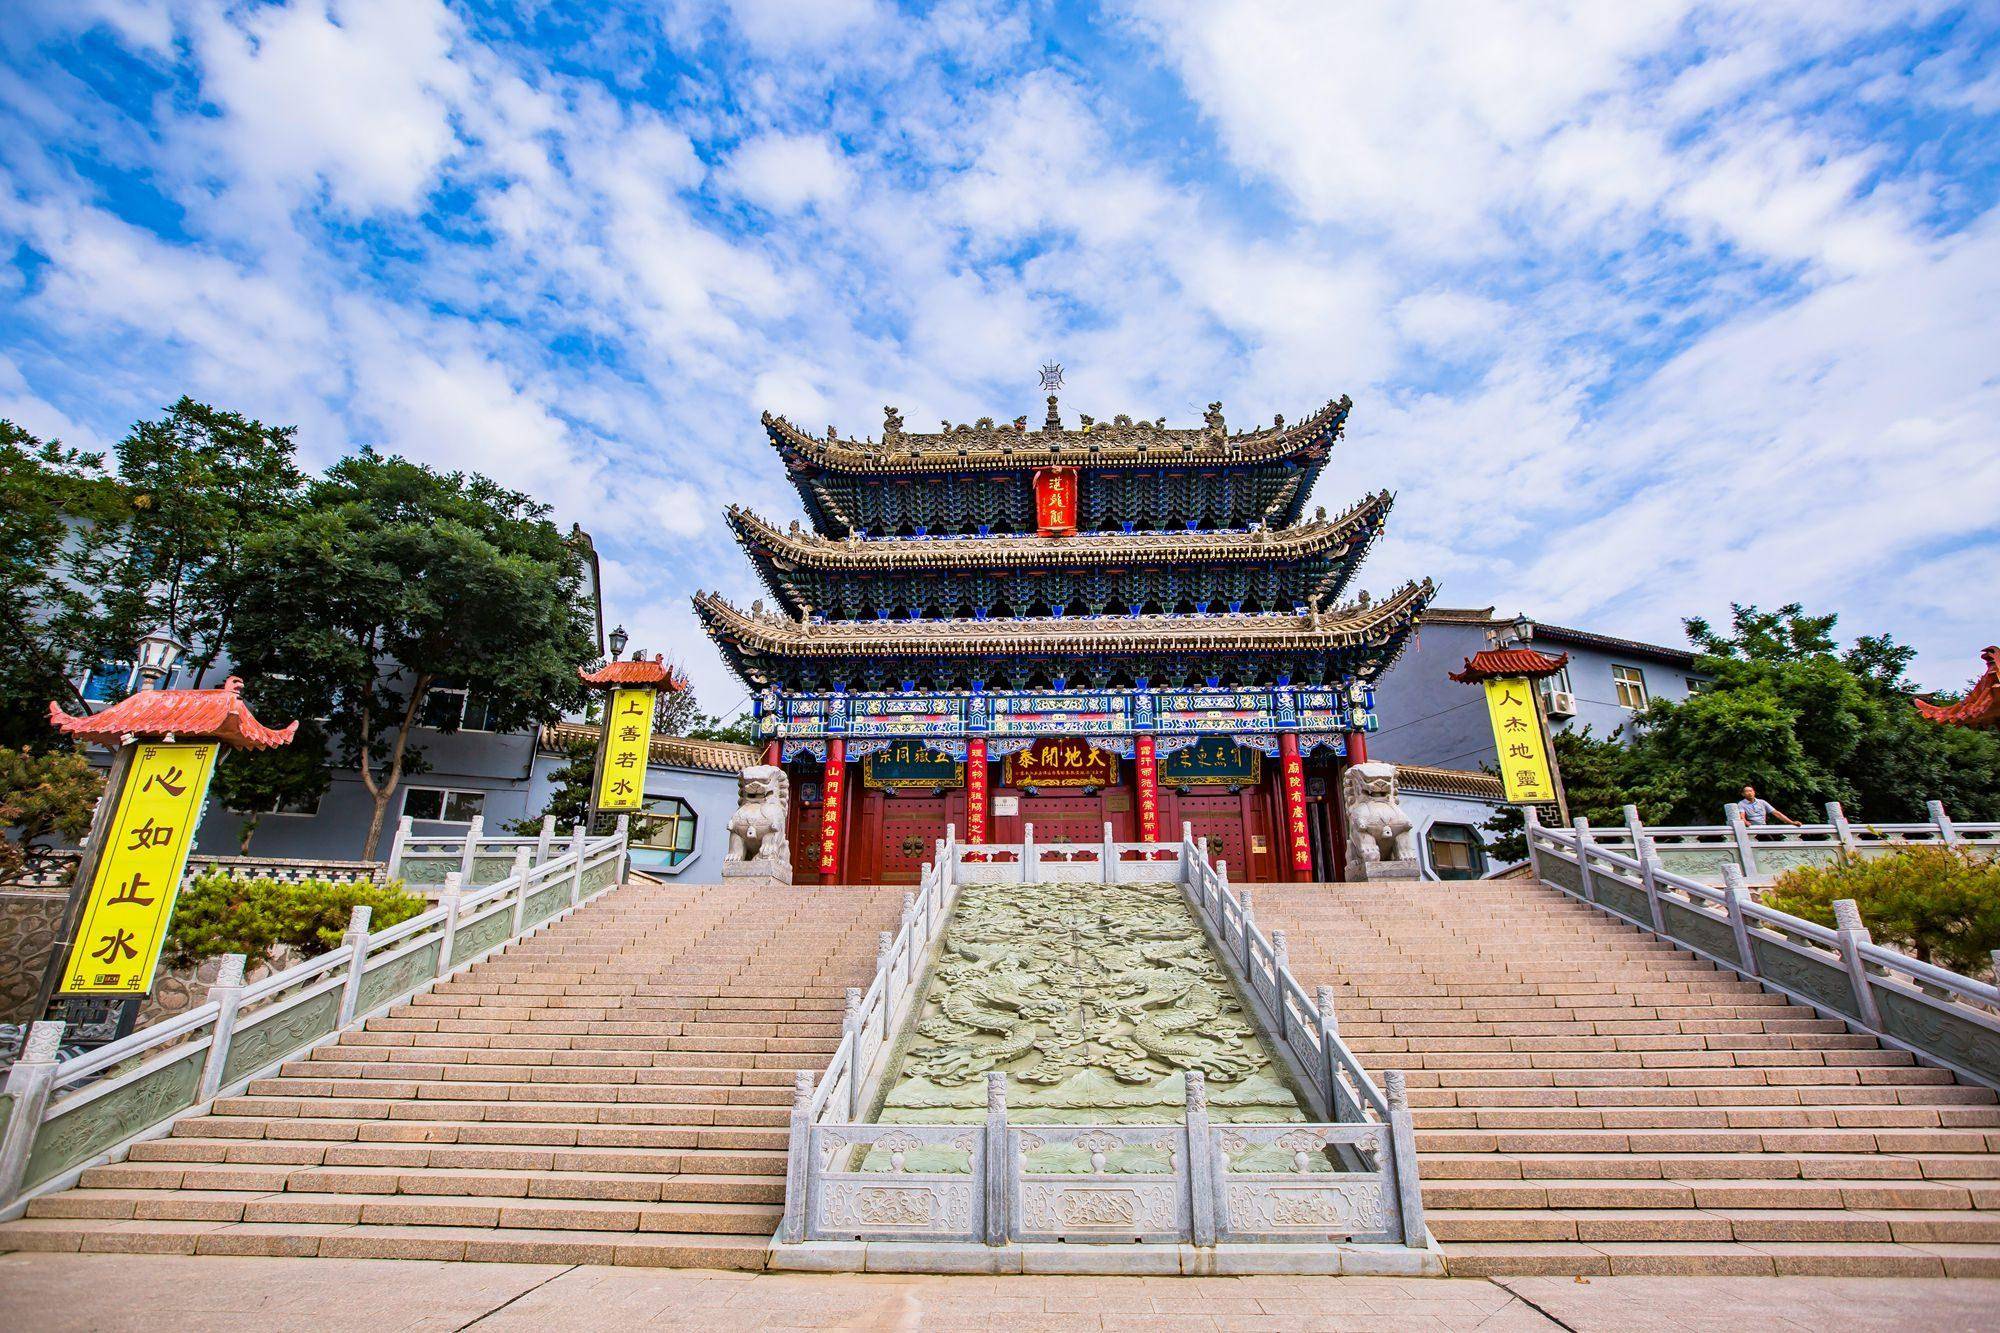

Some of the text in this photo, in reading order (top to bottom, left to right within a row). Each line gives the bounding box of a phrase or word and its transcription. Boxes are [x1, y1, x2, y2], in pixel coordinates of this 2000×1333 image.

[611, 700, 644, 796] 上善若水
[92, 766, 187, 964] 心如止水
